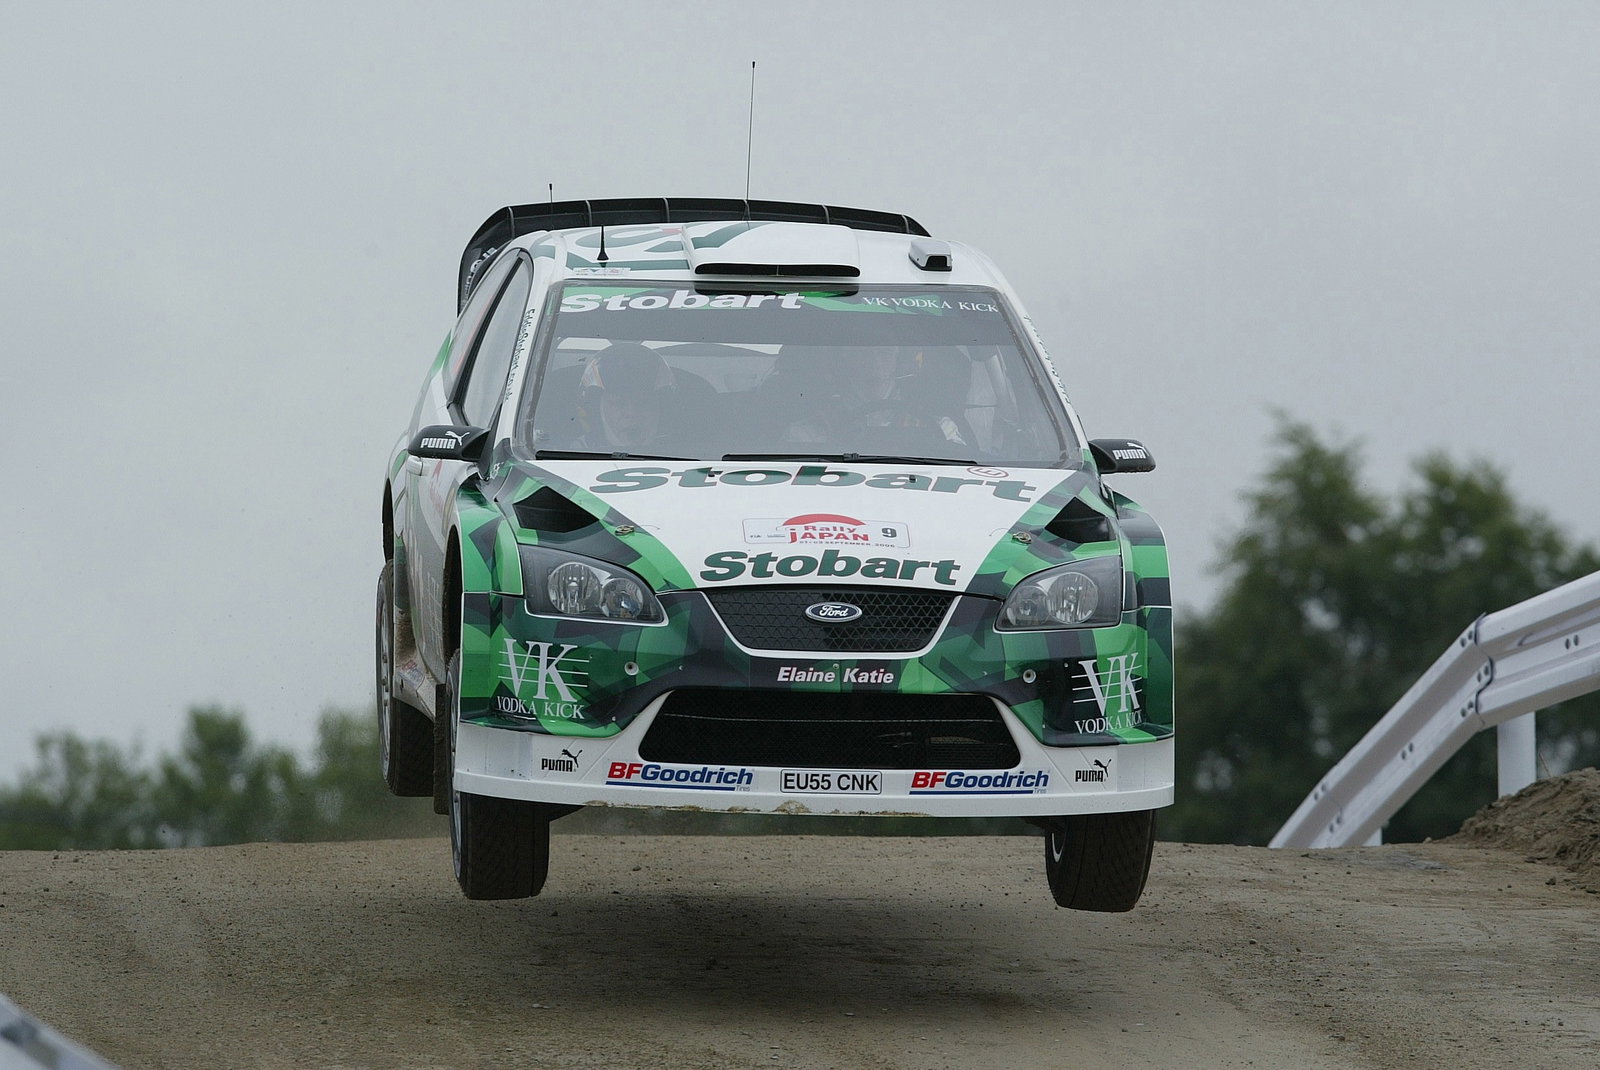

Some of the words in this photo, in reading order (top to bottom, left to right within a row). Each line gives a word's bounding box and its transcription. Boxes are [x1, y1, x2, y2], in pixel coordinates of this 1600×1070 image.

[559, 289, 805, 313] Stobart
[863, 297, 889, 307] VK
[890, 297, 953, 309] VODKA
[958, 301, 999, 313] KICK
[420, 437, 457, 450] PUMA
[1112, 448, 1147, 460] PUMA
[589, 465, 1038, 503] Stobart
[803, 525, 857, 534] Rally
[881, 527, 898, 539] 9
[699, 549, 962, 586] Stobart
[819, 604, 849, 617] Ford
[503, 638, 579, 702] VK
[777, 666, 836, 683] Elaine
[843, 668, 895, 684] Katie
[1078, 652, 1139, 717] VK
[496, 695, 537, 715] VODKA
[544, 701, 585, 720] KICK
[1074, 716, 1122, 735] VODKA
[541, 758, 574, 772] PUMA
[607, 761, 754, 785] BFGoodrich
[783, 772, 832, 791] EU55
[837, 774, 879, 791] CNK
[911, 770, 1049, 789] BFGoodrich
[1075, 770, 1104, 783] PUMA
